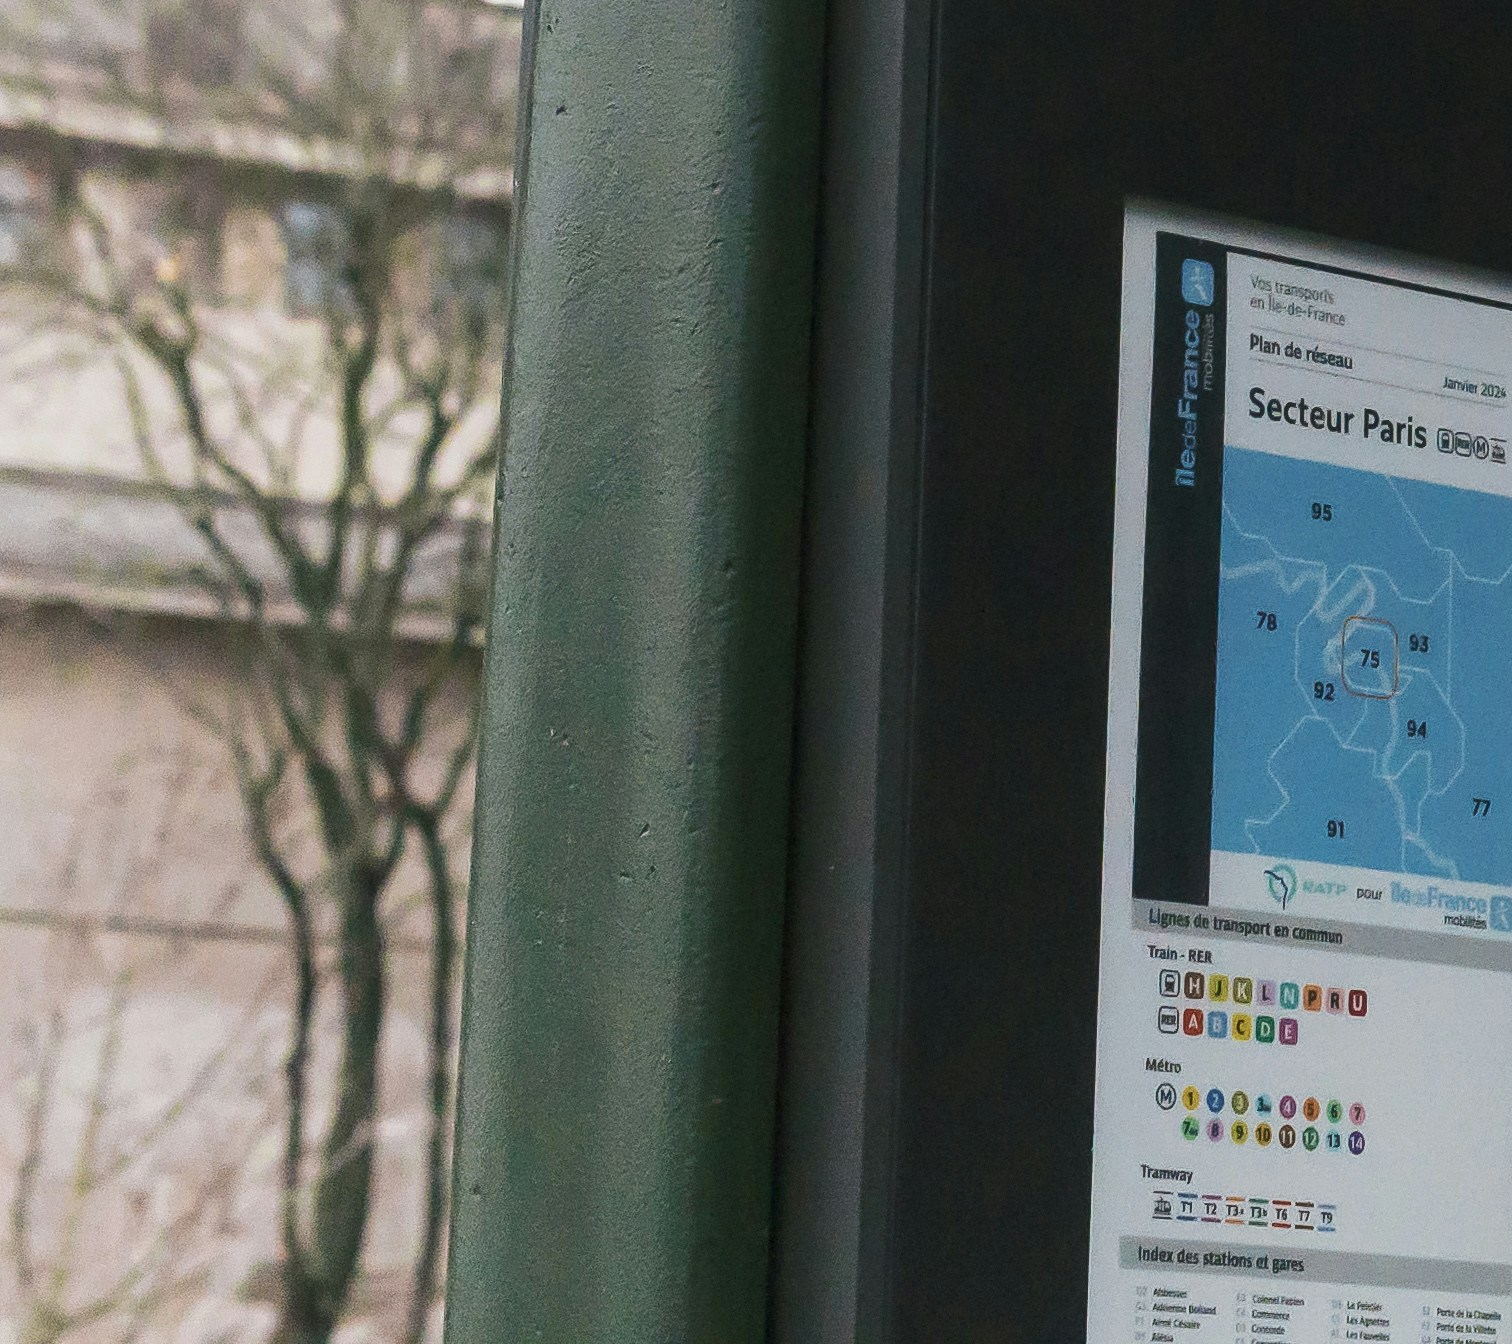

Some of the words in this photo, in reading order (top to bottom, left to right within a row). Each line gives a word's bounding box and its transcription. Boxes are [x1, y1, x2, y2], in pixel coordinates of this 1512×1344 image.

[1251, 275, 1272, 292] Vos
[1275, 281, 1335, 304] transports
[1251, 296, 1265, 310] en
[1250, 333, 1281, 358] Plan
[1284, 341, 1302, 360] de
[1306, 346, 1353, 370] réseau
[1444, 376, 1478, 393] Janvier
[1248, 387, 1354, 434] Secteur
[1363, 408, 1427, 448] Paris
[1311, 503, 1332, 521] 95
[1256, 611, 1277, 630] 78
[1409, 634, 1429, 653] 93
[1361, 649, 1380, 668] 75
[1314, 682, 1335, 701] 92
[1407, 720, 1427, 738] 94
[1472, 799, 1491, 817] 77
[1327, 820, 1345, 838] 91
[1302, 883, 1347, 896] RATP
[1357, 887, 1382, 901] pour
[1149, 908, 1190, 929] Lignes
[1194, 914, 1210, 929] de
[1213, 916, 1270, 937] transport
[1274, 926, 1289, 938] en
[1292, 928, 1342, 944] commun
[1148, 945, 1178, 960] Train
[1189, 949, 1212, 963] RER
[1146, 1058, 1181, 1073] Métro
[1257, 1128, 1270, 1141] 10
[1280, 1130, 1293, 1143] 11
[1304, 1132, 1317, 1145] 12
[1328, 1134, 1340, 1148] 13
[1350, 1136, 1363, 1149] 14
[1141, 1164, 1193, 1184] Tramway
[1181, 1201, 1192, 1213] T1
[1204, 1203, 1217, 1215] T2
[1276, 1209, 1287, 1220] T6
[1299, 1210, 1310, 1221] T7
[1321, 1212, 1332, 1223] T9
[1138, 1246, 1173, 1261] Index
[1177, 1249, 1199, 1263] des
[1203, 1252, 1252, 1267] stations
[1256, 1255, 1268, 1269] et
[1272, 1258, 1304, 1274] gares
